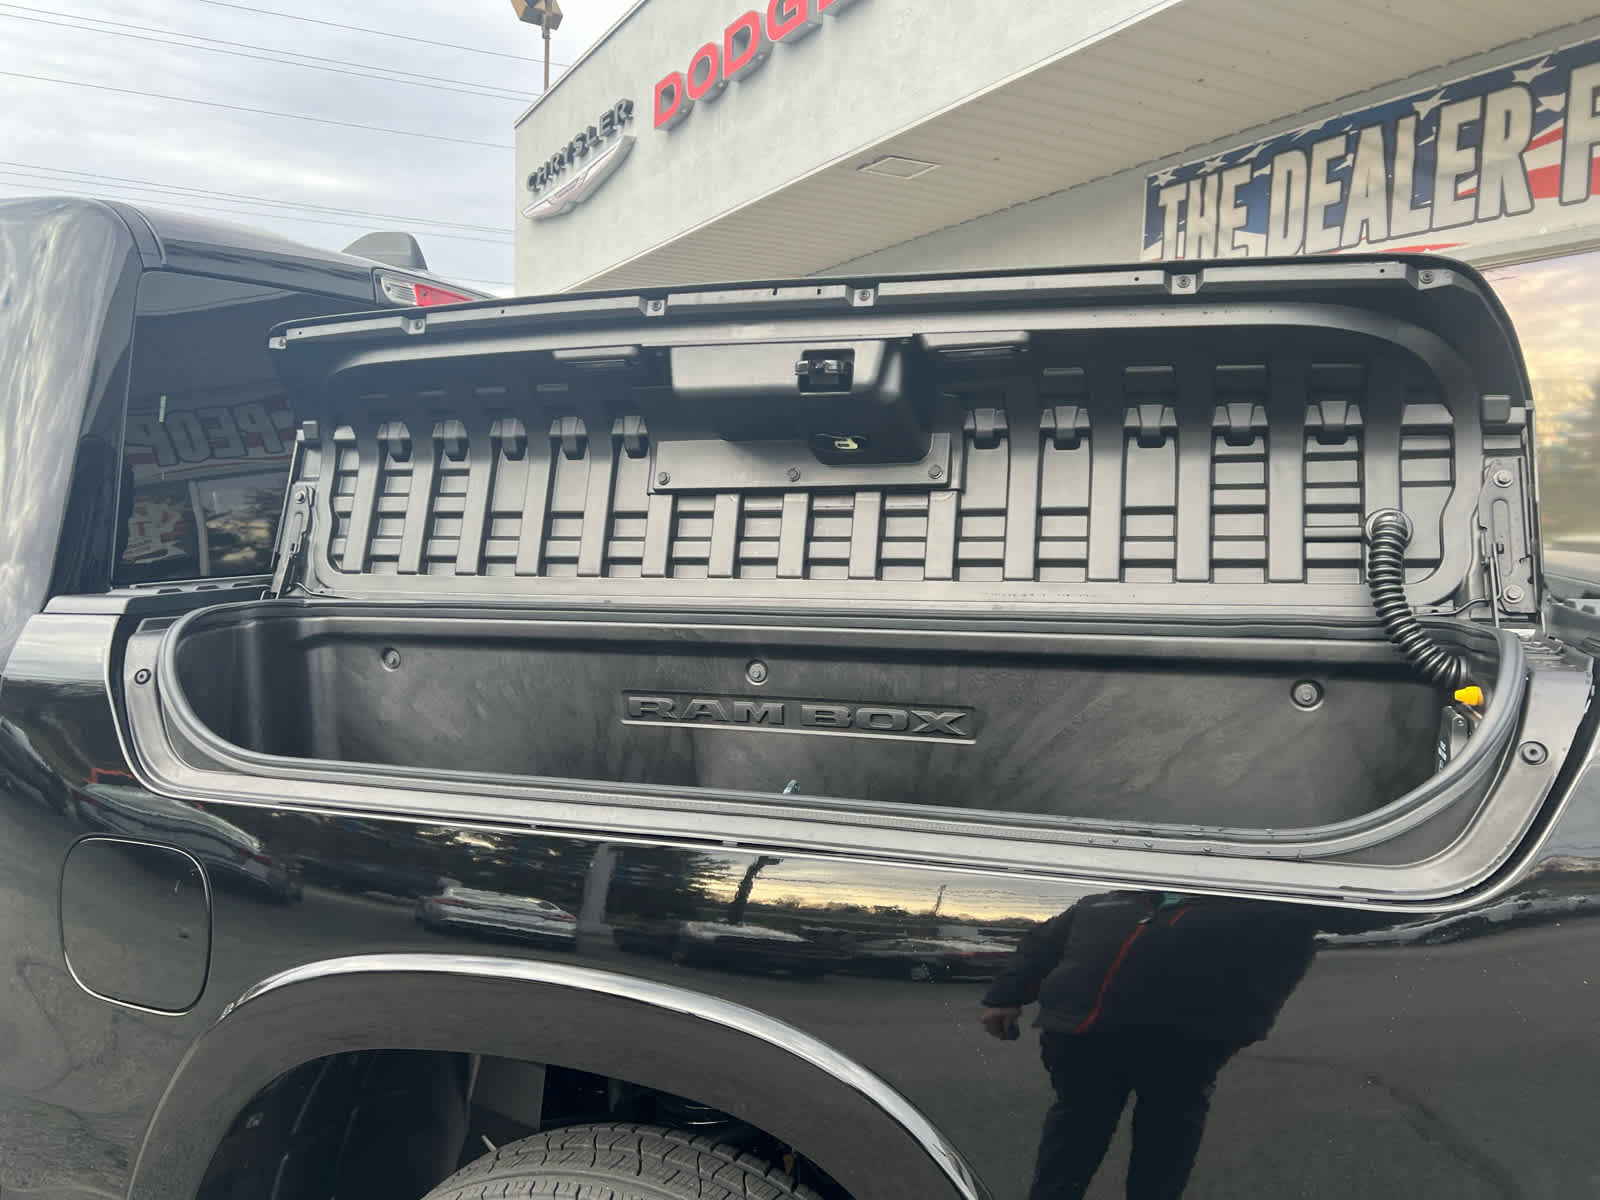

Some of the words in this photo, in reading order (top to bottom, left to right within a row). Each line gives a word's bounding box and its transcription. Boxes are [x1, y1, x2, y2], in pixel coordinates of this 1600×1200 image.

[654, 0, 842, 129] DODG
[526, 98, 635, 193] CHRYSLER
[1158, 161, 1254, 258] THE
[1265, 82, 1535, 256] DEALER
[627, 696, 785, 725] RAM
[800, 703, 969, 736] BOX
